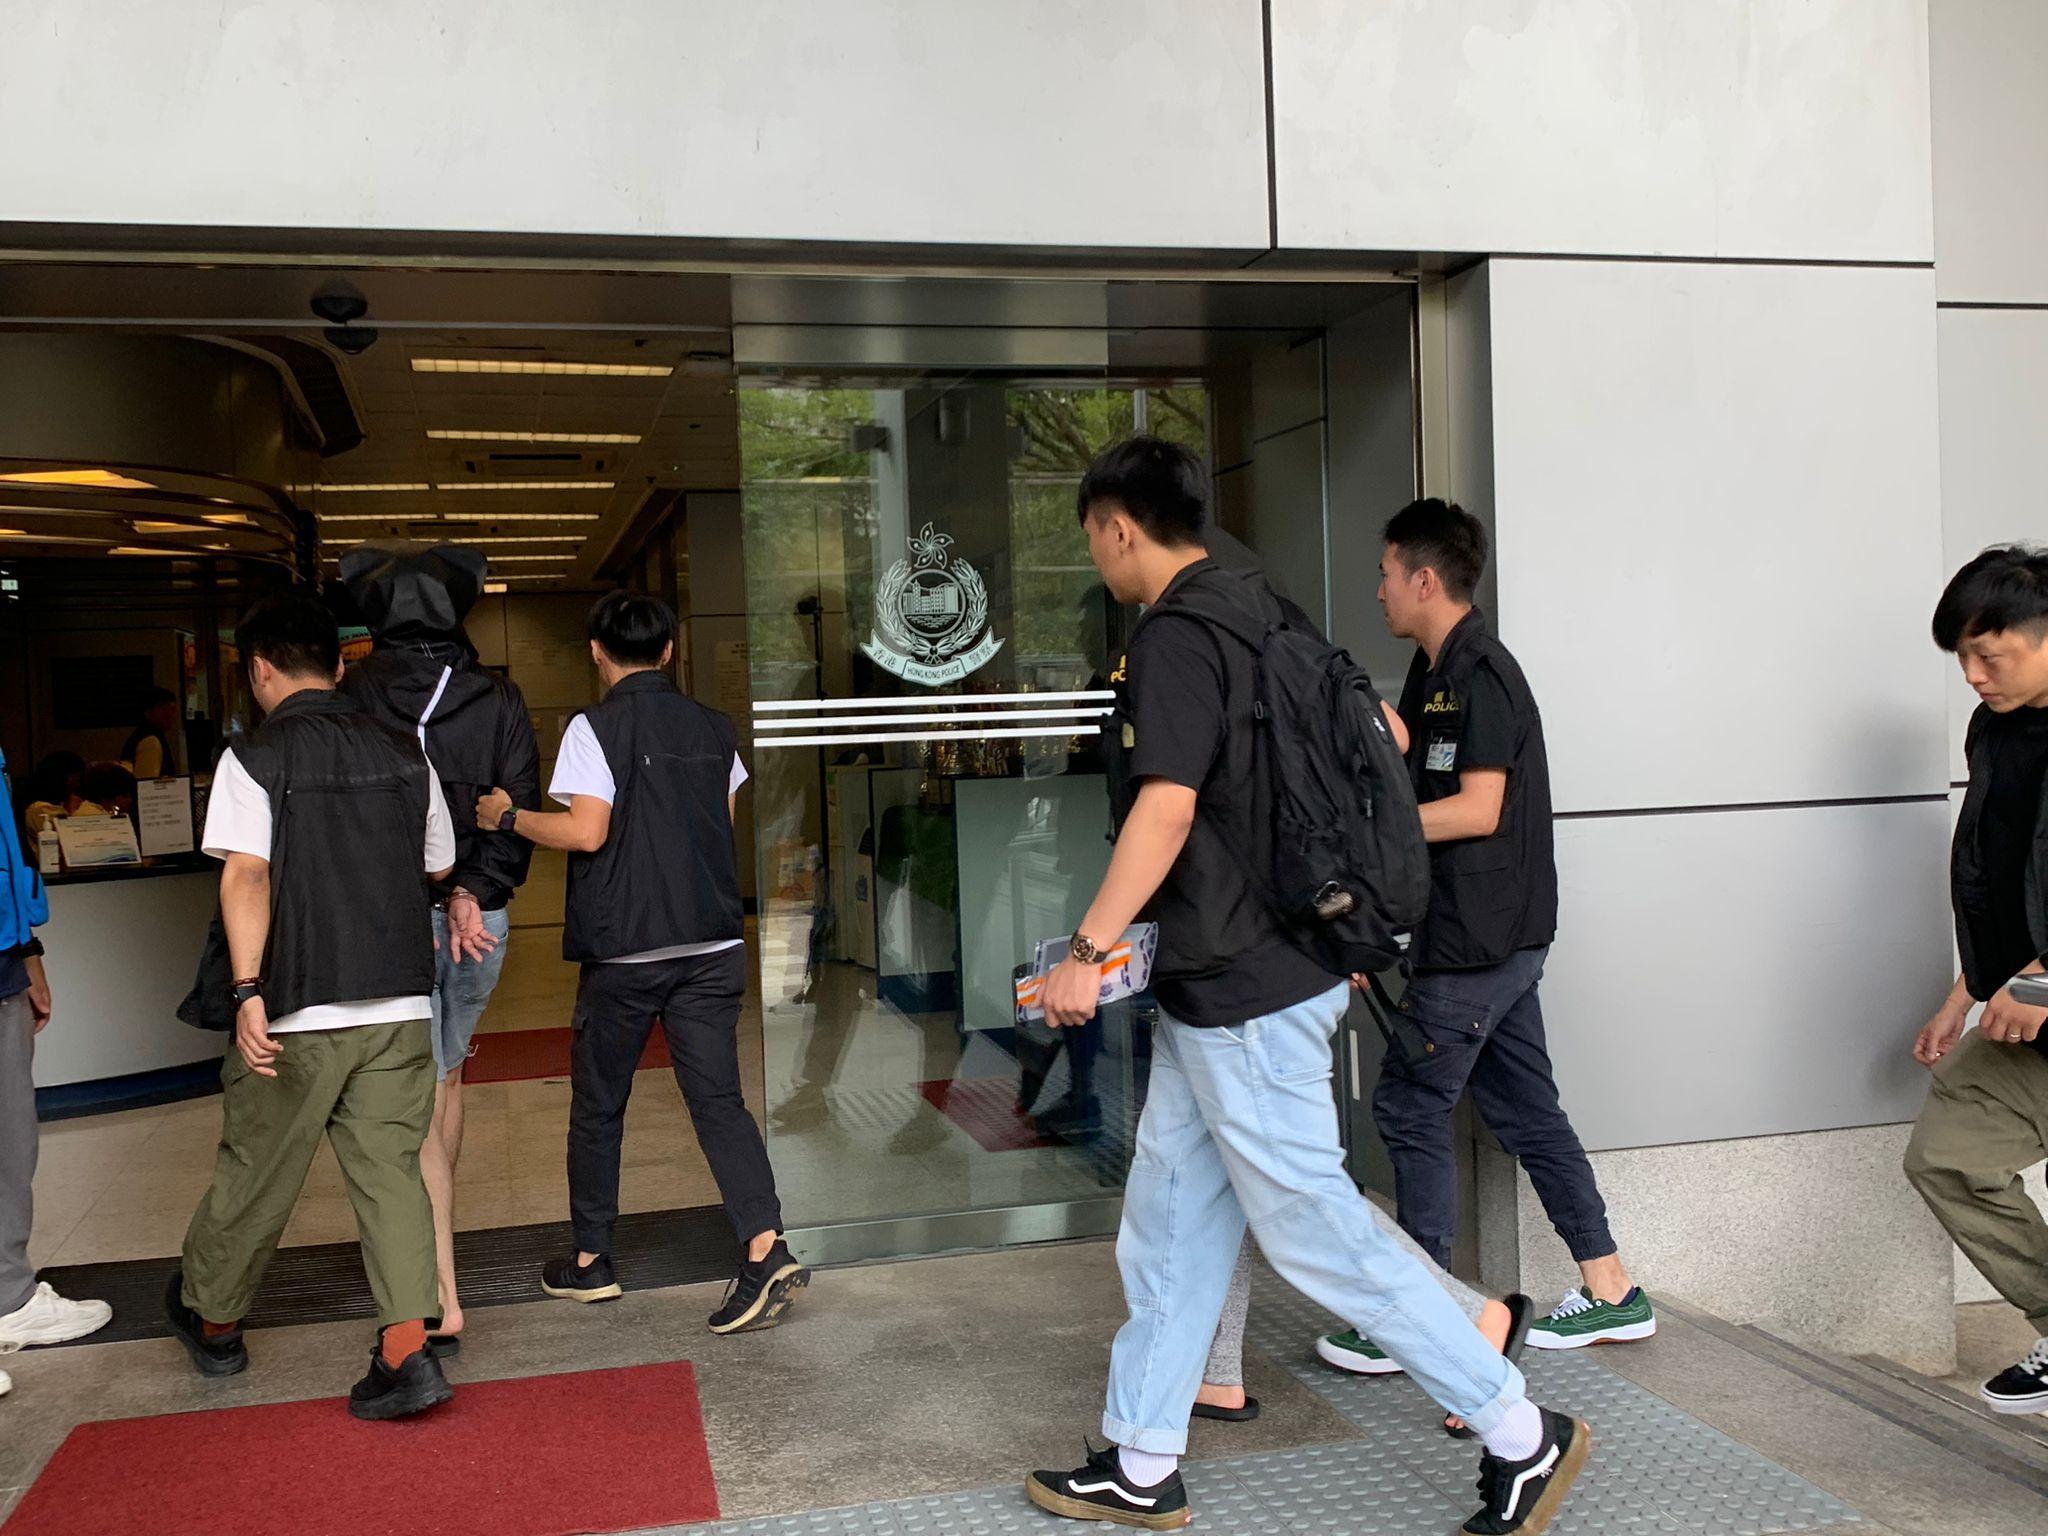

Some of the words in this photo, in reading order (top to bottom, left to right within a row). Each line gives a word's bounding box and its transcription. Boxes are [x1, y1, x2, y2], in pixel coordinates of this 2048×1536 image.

[907, 667, 923, 678] HONG
[925, 670, 940, 679] KONG
[941, 664, 960, 677] POLICE
[1424, 702, 1459, 713] POLIC
